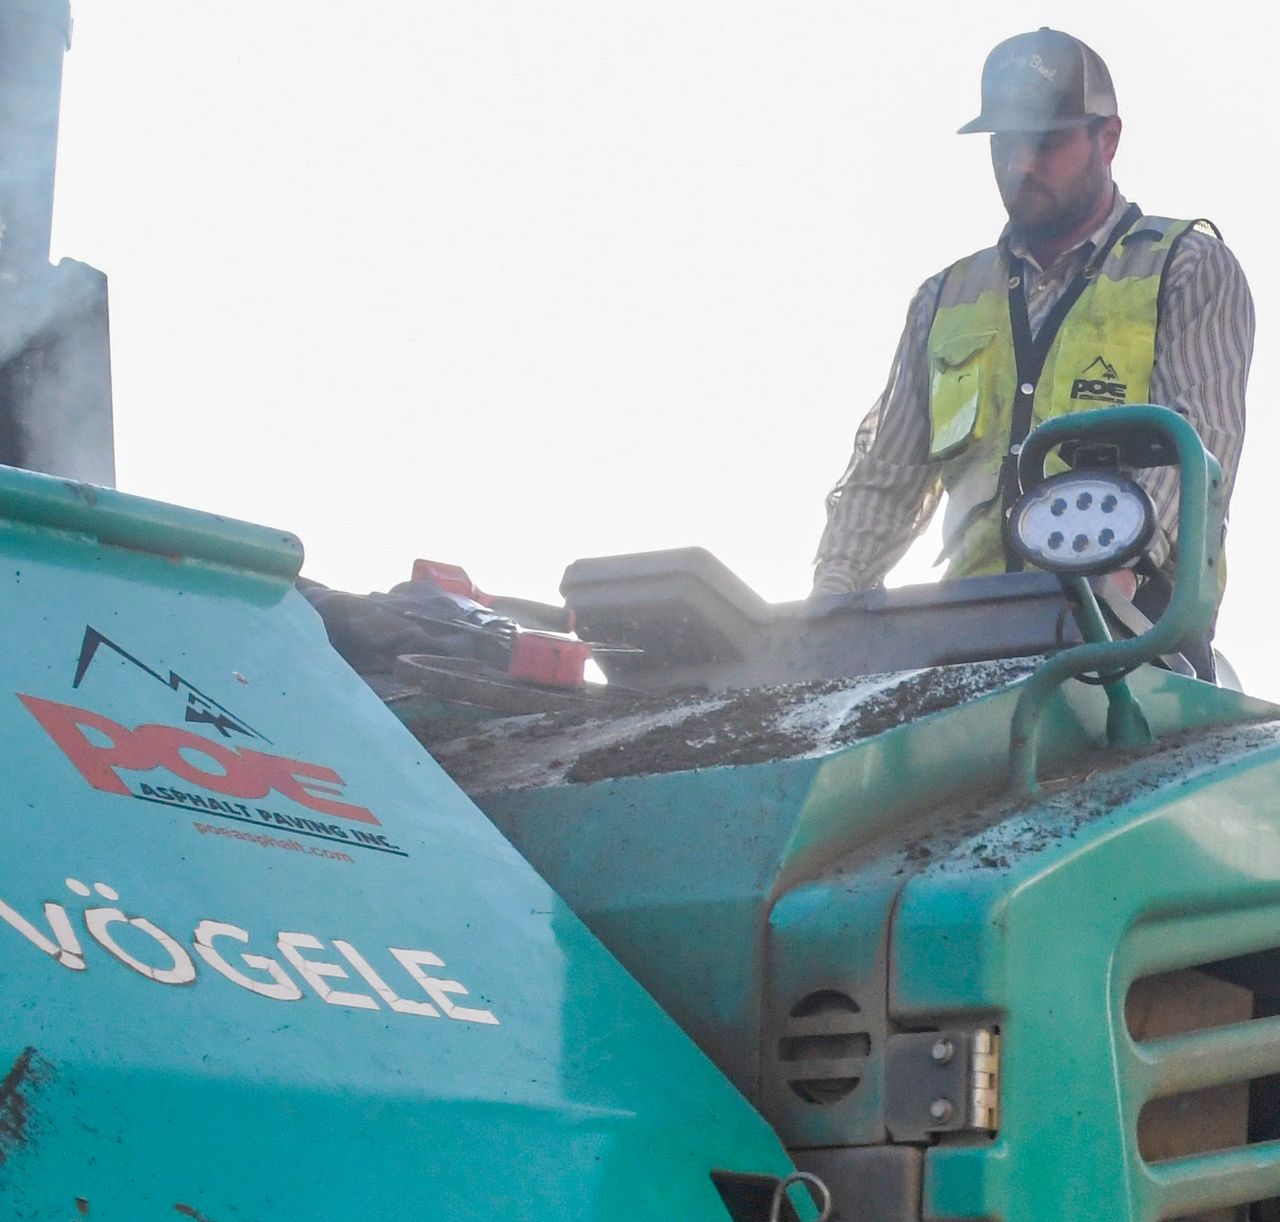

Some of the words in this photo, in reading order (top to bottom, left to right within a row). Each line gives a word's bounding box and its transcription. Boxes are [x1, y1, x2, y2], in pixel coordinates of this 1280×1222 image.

[1071, 379, 1127, 399] POE
[16, 693, 381, 826] POE
[139, 782, 252, 818] ASPHALT
[255, 808, 349, 840] PAVING
[350, 828, 401, 850] INC.
[192, 821, 356, 863] poeasphalt.com
[0, 877, 500, 1025] VÖGELE
